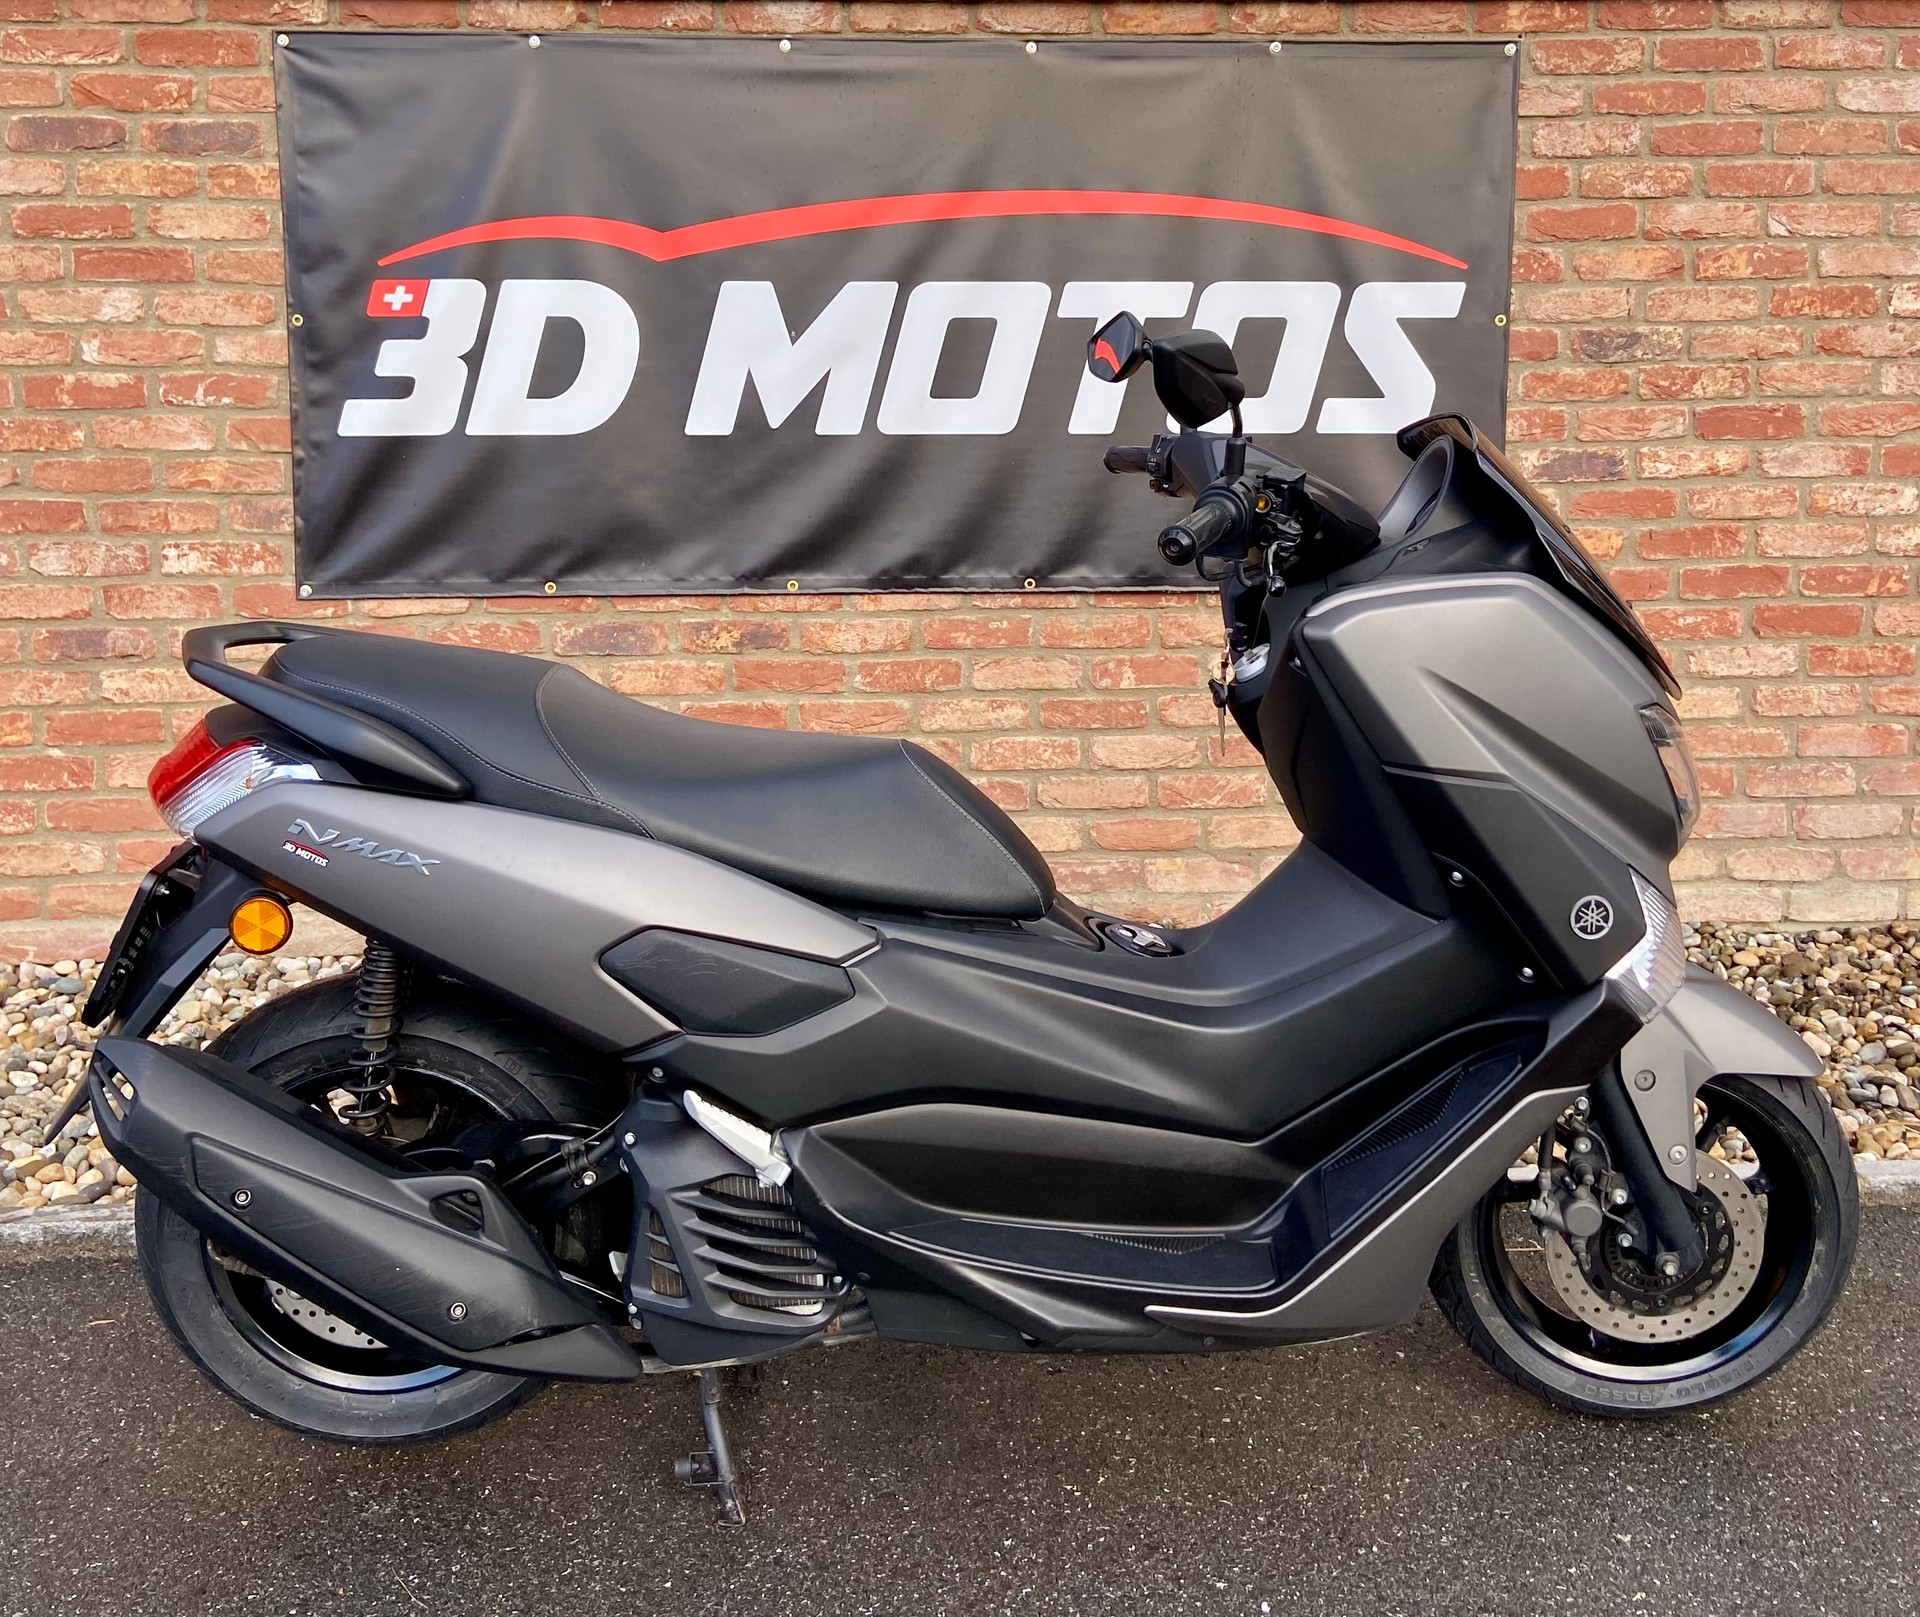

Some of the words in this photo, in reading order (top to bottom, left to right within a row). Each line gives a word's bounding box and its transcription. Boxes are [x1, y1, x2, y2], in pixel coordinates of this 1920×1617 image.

[337, 278, 641, 437] 3D
[684, 280, 1467, 436] MOTOS
[282, 841, 297, 854] 3D
[295, 847, 329, 867] MOTOS
[287, 817, 442, 876] NMAX
[1584, 1383, 1654, 1402] ROSSO
